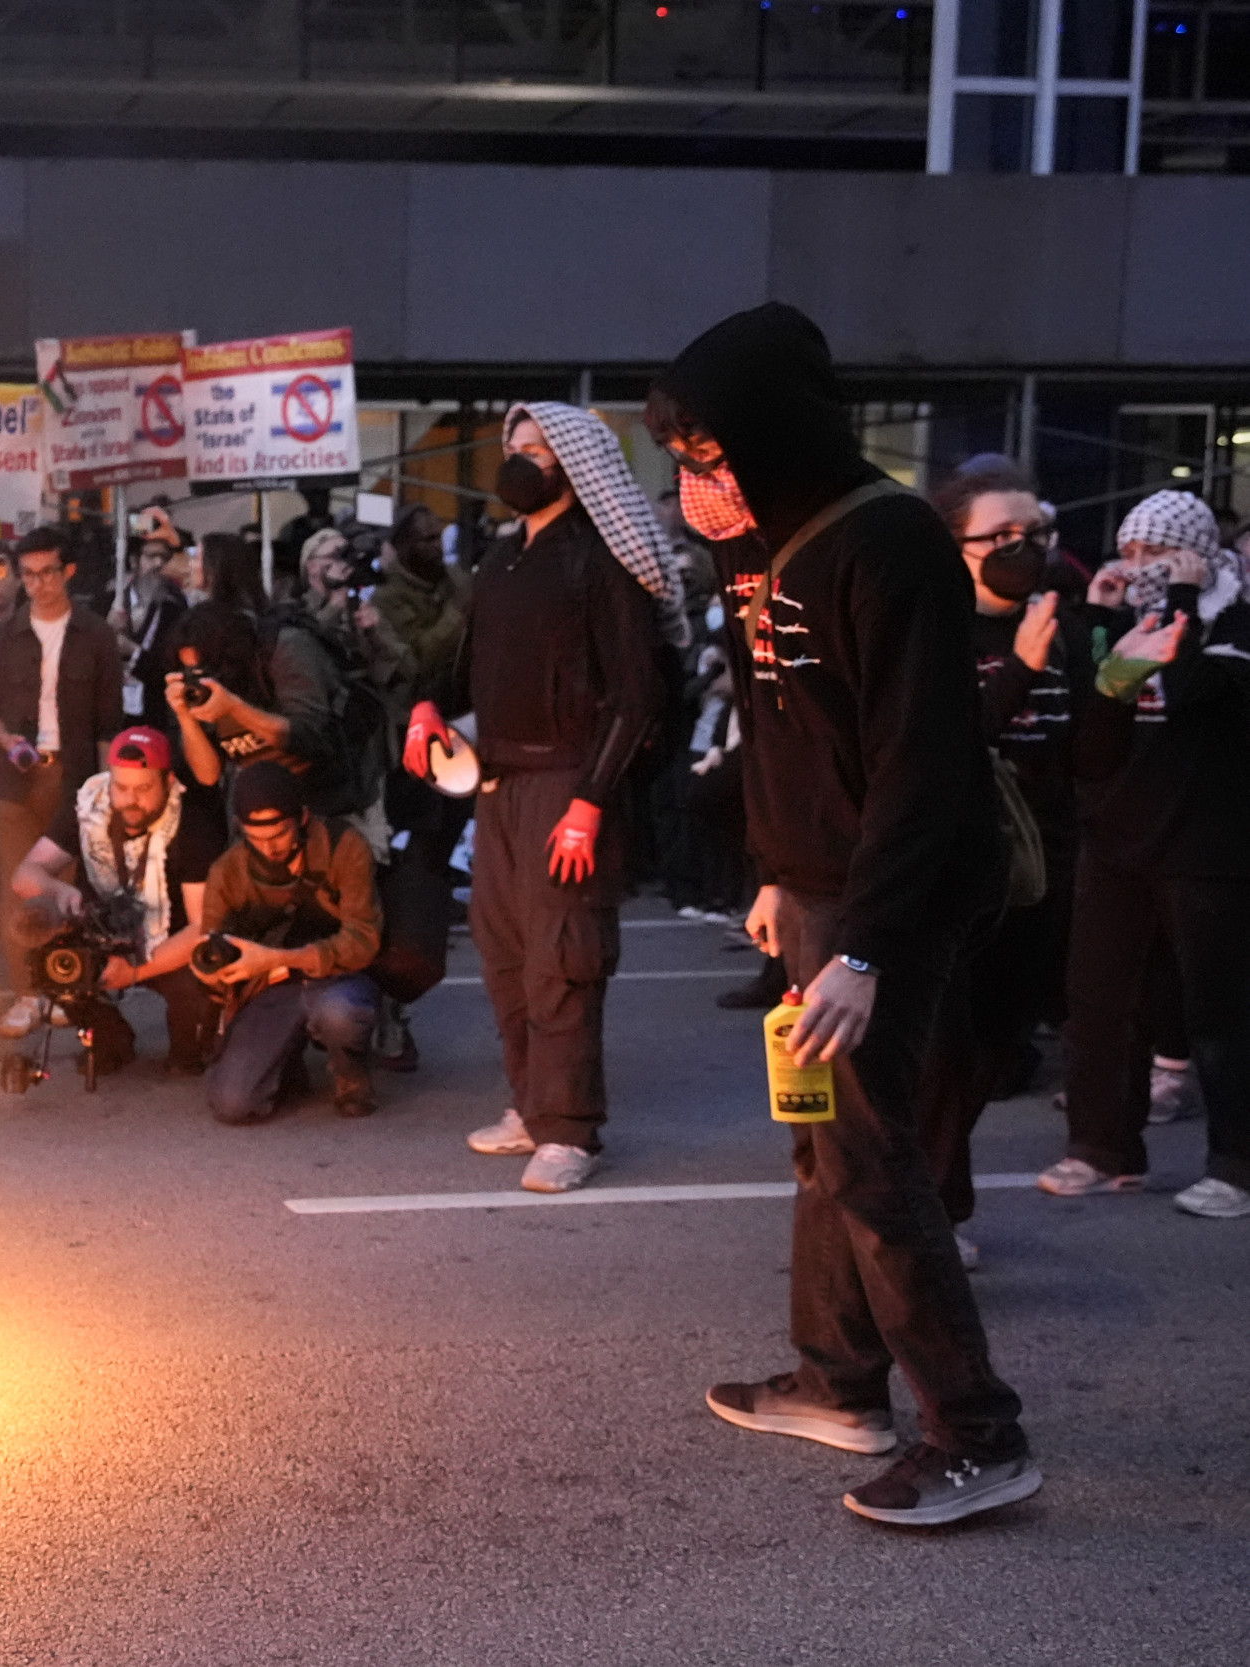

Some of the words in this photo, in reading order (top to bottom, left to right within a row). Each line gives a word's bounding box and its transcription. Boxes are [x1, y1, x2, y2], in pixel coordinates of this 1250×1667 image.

[210, 383, 235, 400] the
[194, 407, 235, 426] State
[238, 404, 255, 422] of
[195, 454, 225, 474] And
